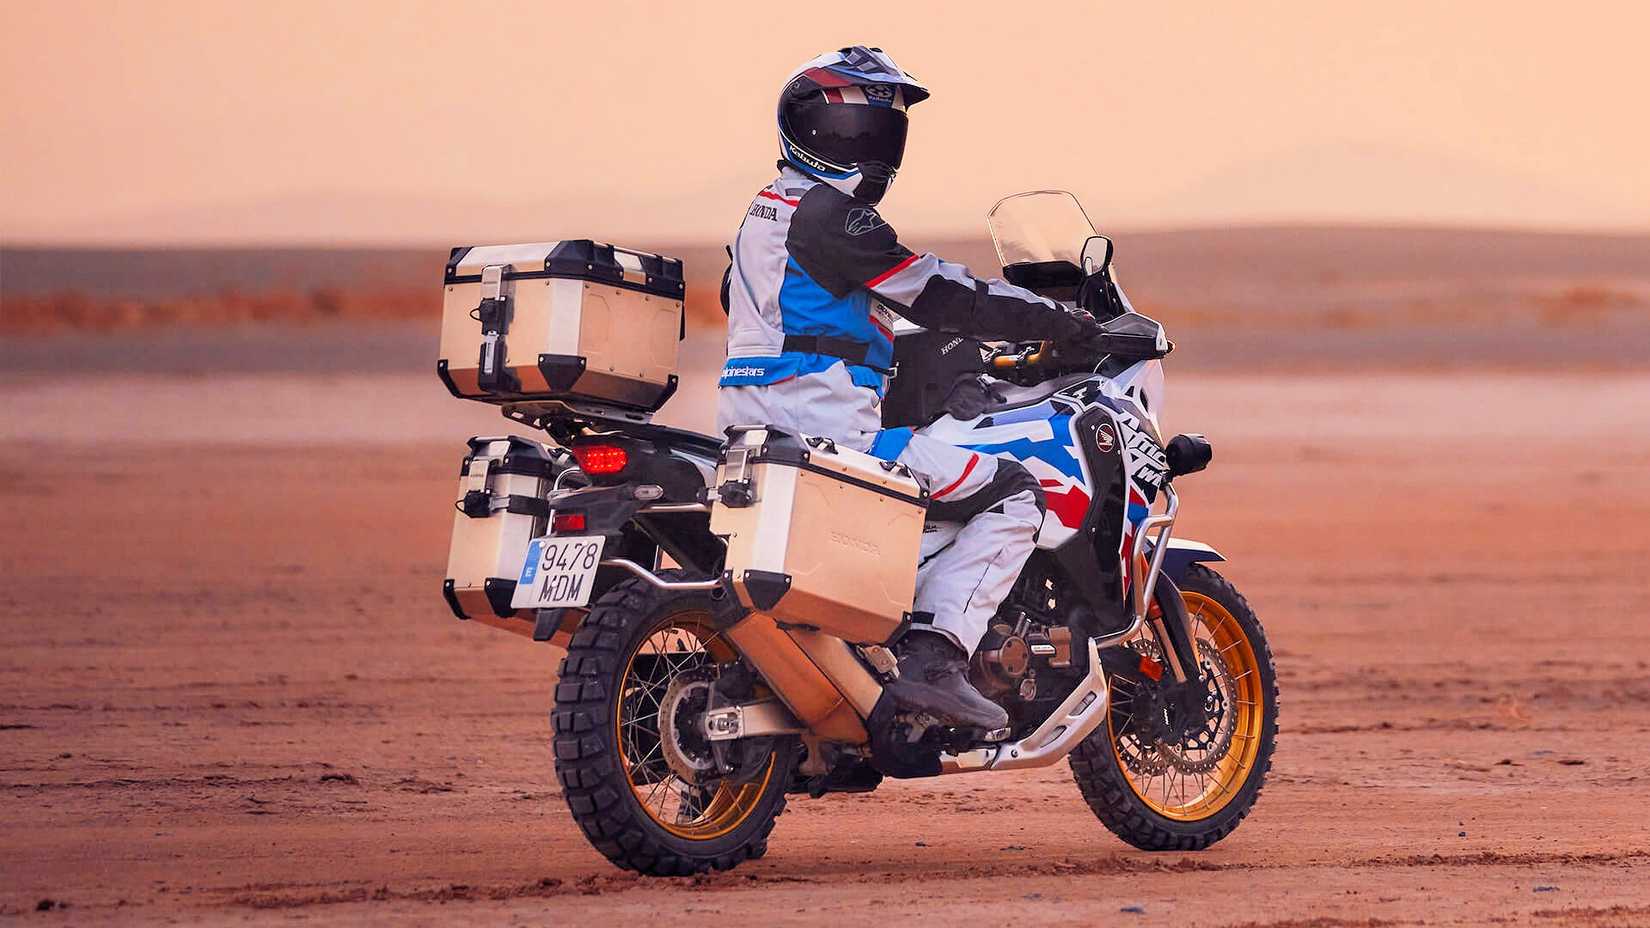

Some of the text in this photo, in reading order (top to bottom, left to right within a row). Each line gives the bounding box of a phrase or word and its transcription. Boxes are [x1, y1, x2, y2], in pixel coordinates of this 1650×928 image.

[525, 567, 533, 577] E
[542, 543, 598, 572] 9478
[538, 573, 584, 602] MDM
